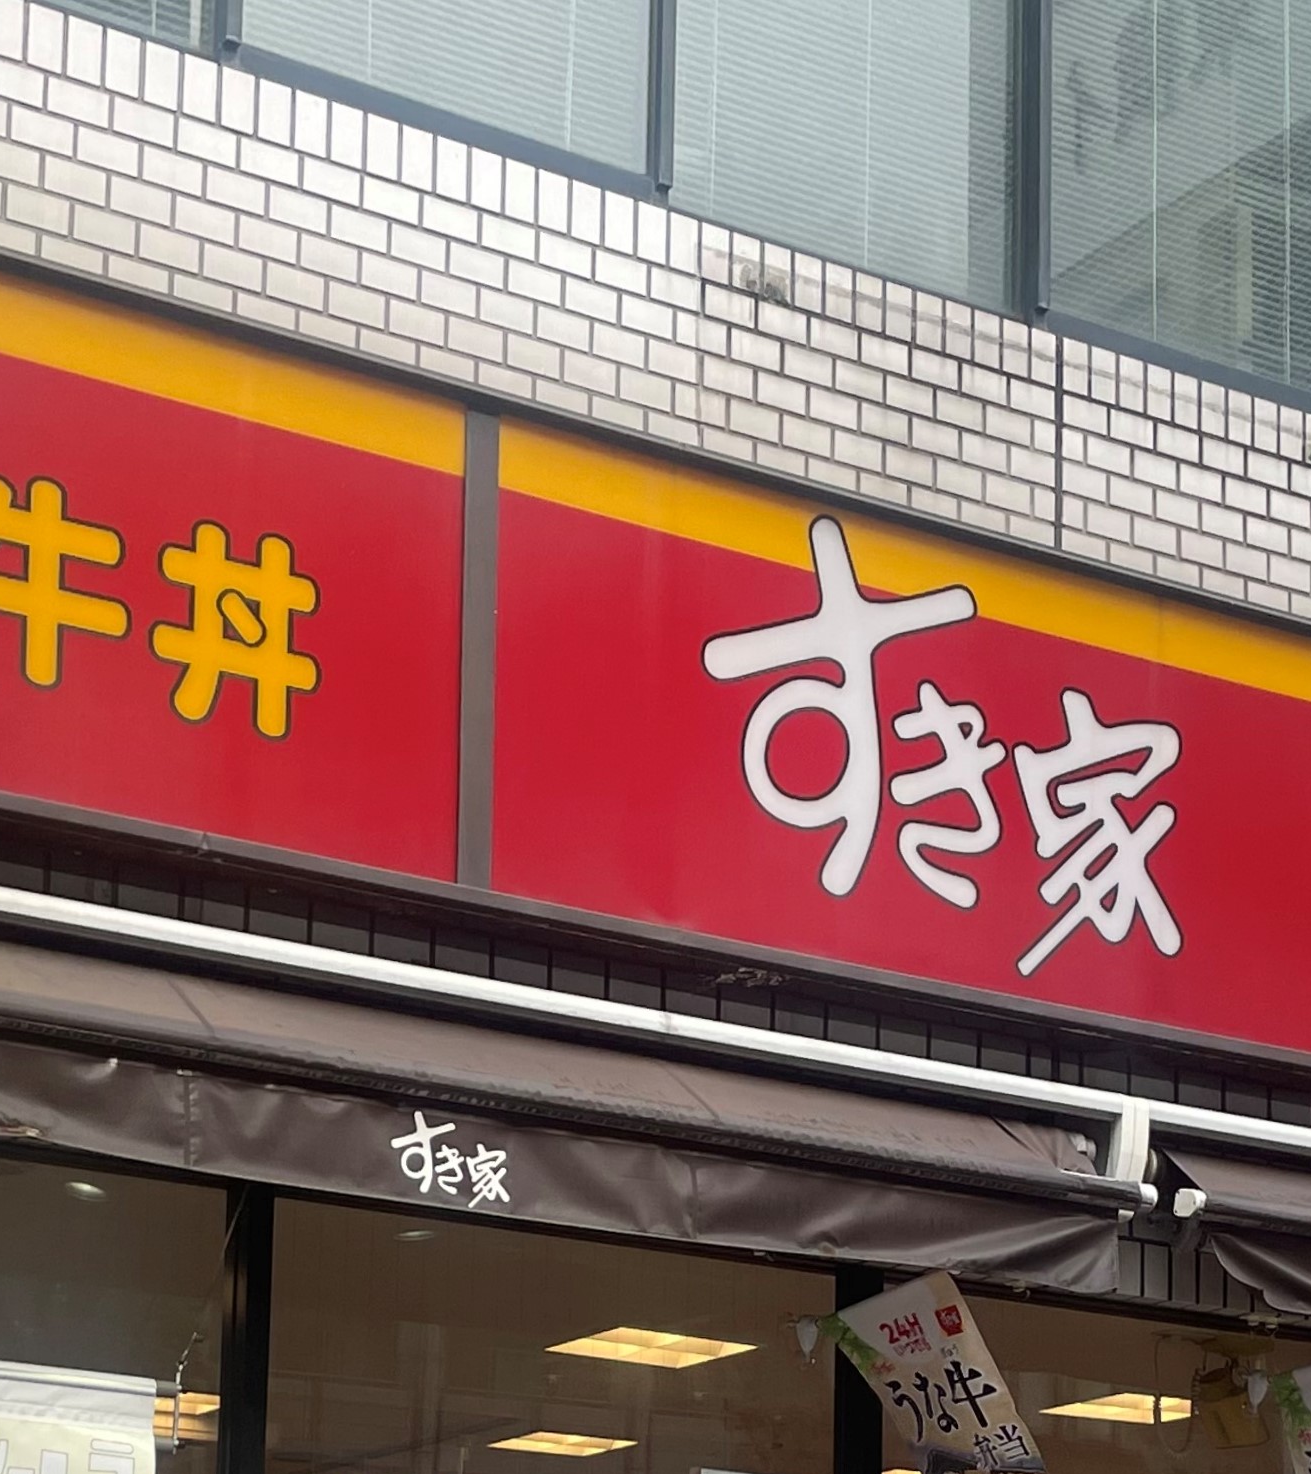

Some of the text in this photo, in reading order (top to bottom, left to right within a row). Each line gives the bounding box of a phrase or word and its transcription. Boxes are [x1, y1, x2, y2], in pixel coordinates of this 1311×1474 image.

[701, 514, 1182, 976] すき家
[390, 1110, 510, 1208] すき家
[884, 1360, 997, 1443] うな牛
